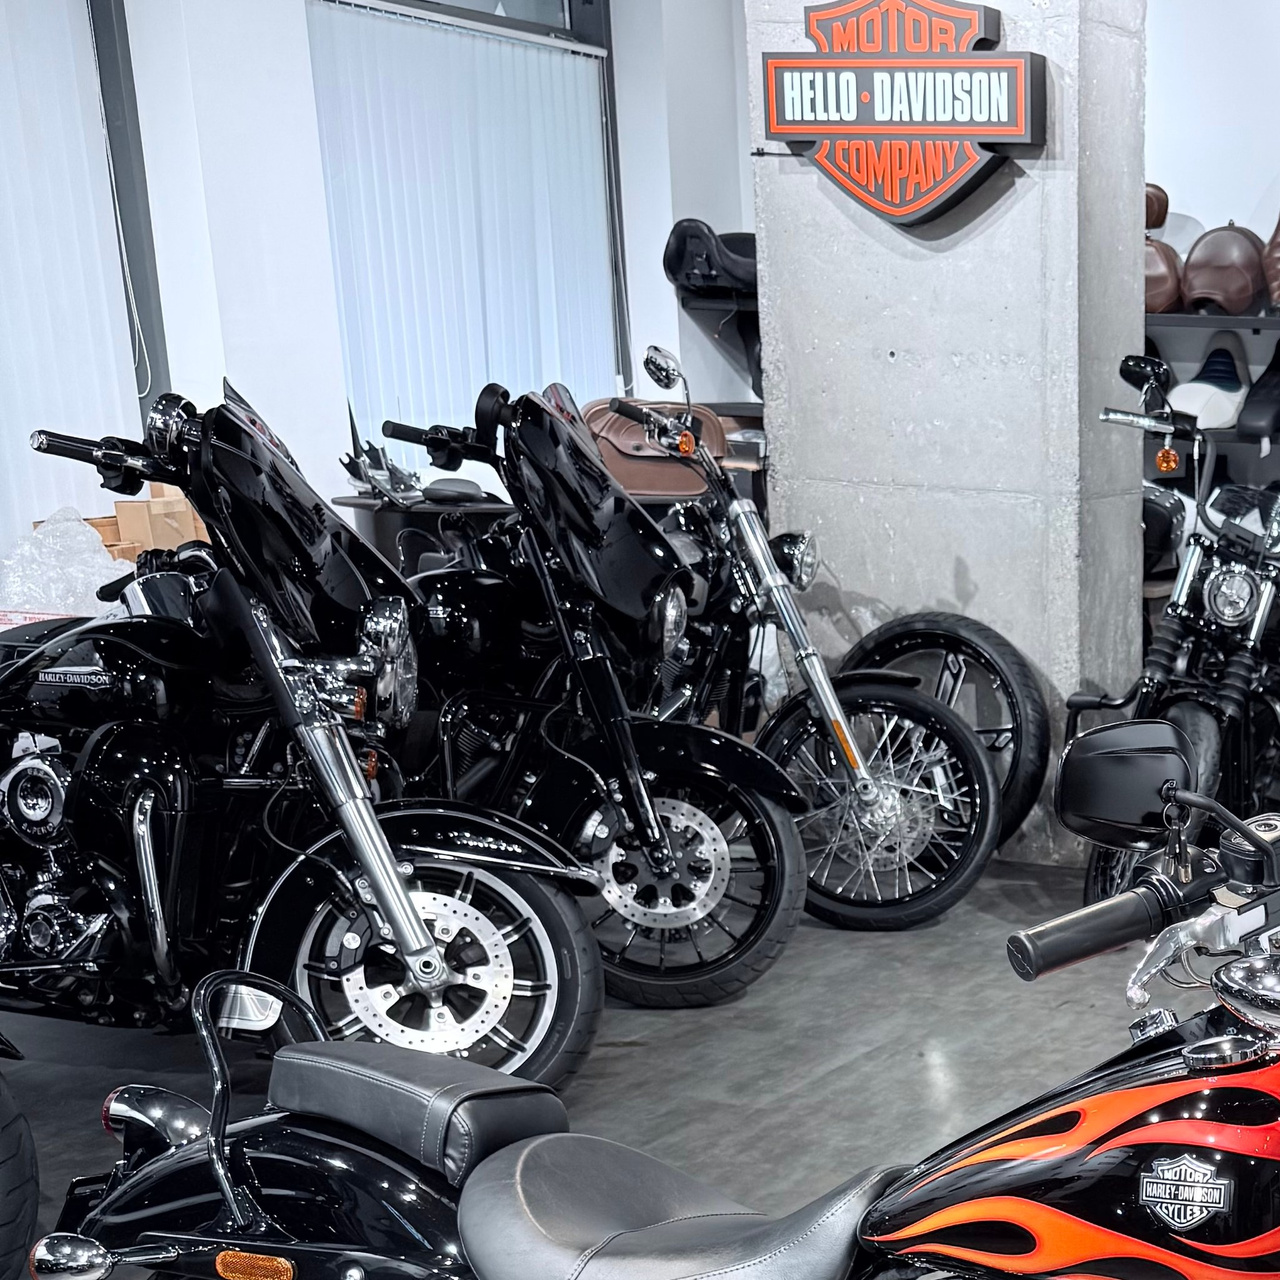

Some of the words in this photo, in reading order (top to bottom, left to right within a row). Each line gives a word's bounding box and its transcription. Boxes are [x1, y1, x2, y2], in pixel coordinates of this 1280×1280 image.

[832, 1, 956, 53] MOTOR
[783, 71, 858, 121] HELLO
[874, 71, 1008, 122] DAVIDSON
[834, 140, 959, 204] COMPANY
[39, 672, 109, 684] HARLEY-DAVIDSON
[1163, 1165, 1204, 1183] MOTOR
[1146, 1182, 1220, 1203] HARLEY-DAVSON
[1161, 1203, 1201, 1223] CYCLES
